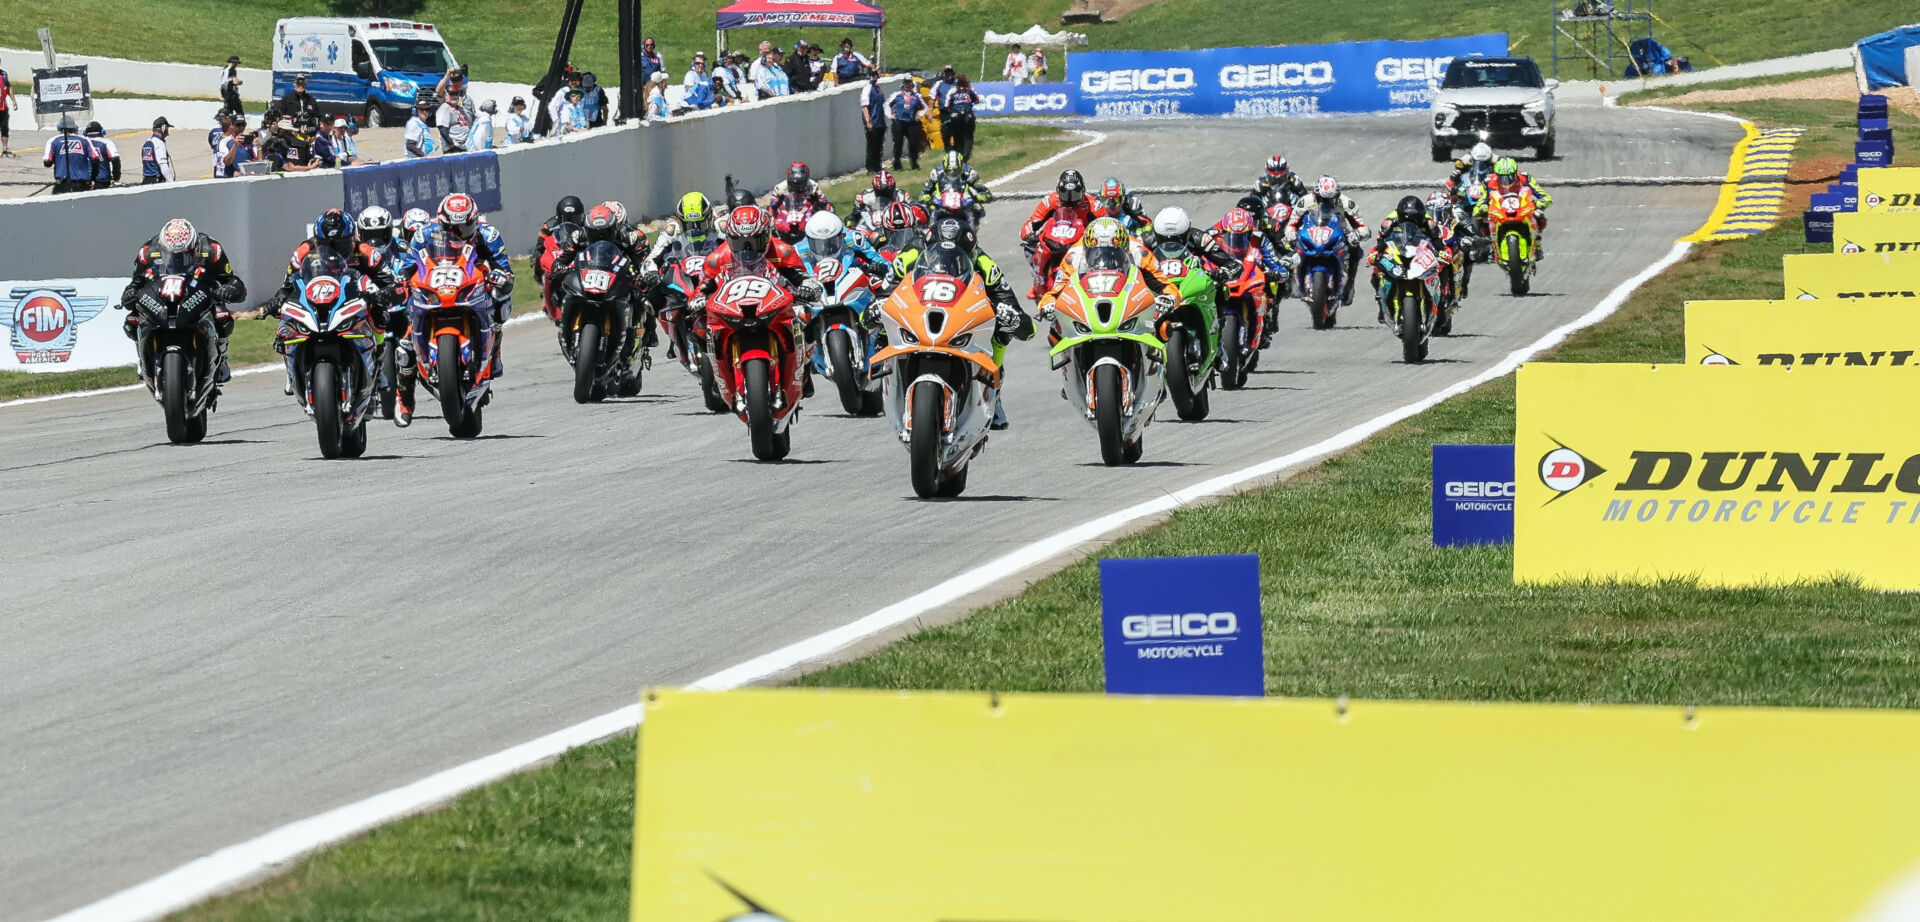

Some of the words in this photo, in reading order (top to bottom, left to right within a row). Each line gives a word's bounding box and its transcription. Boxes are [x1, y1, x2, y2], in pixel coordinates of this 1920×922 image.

[1080, 67, 1194, 93] GEICO
[1219, 60, 1333, 89] GEICO
[1375, 56, 1457, 82] GEIC
[685, 257, 704, 274] 92
[818, 261, 839, 280] 21
[161, 279, 183, 294] 44
[430, 267, 463, 289] 69
[582, 272, 611, 291] 98
[725, 279, 772, 304] 99
[22, 305, 65, 332] FIM
[1455, 502, 1513, 511] MOTORCYCLE
[1601, 499, 1866, 524] MOTORCYCLE
[1121, 611, 1238, 640] GEICO
[1137, 644, 1225, 660] MOTORCYCLE
